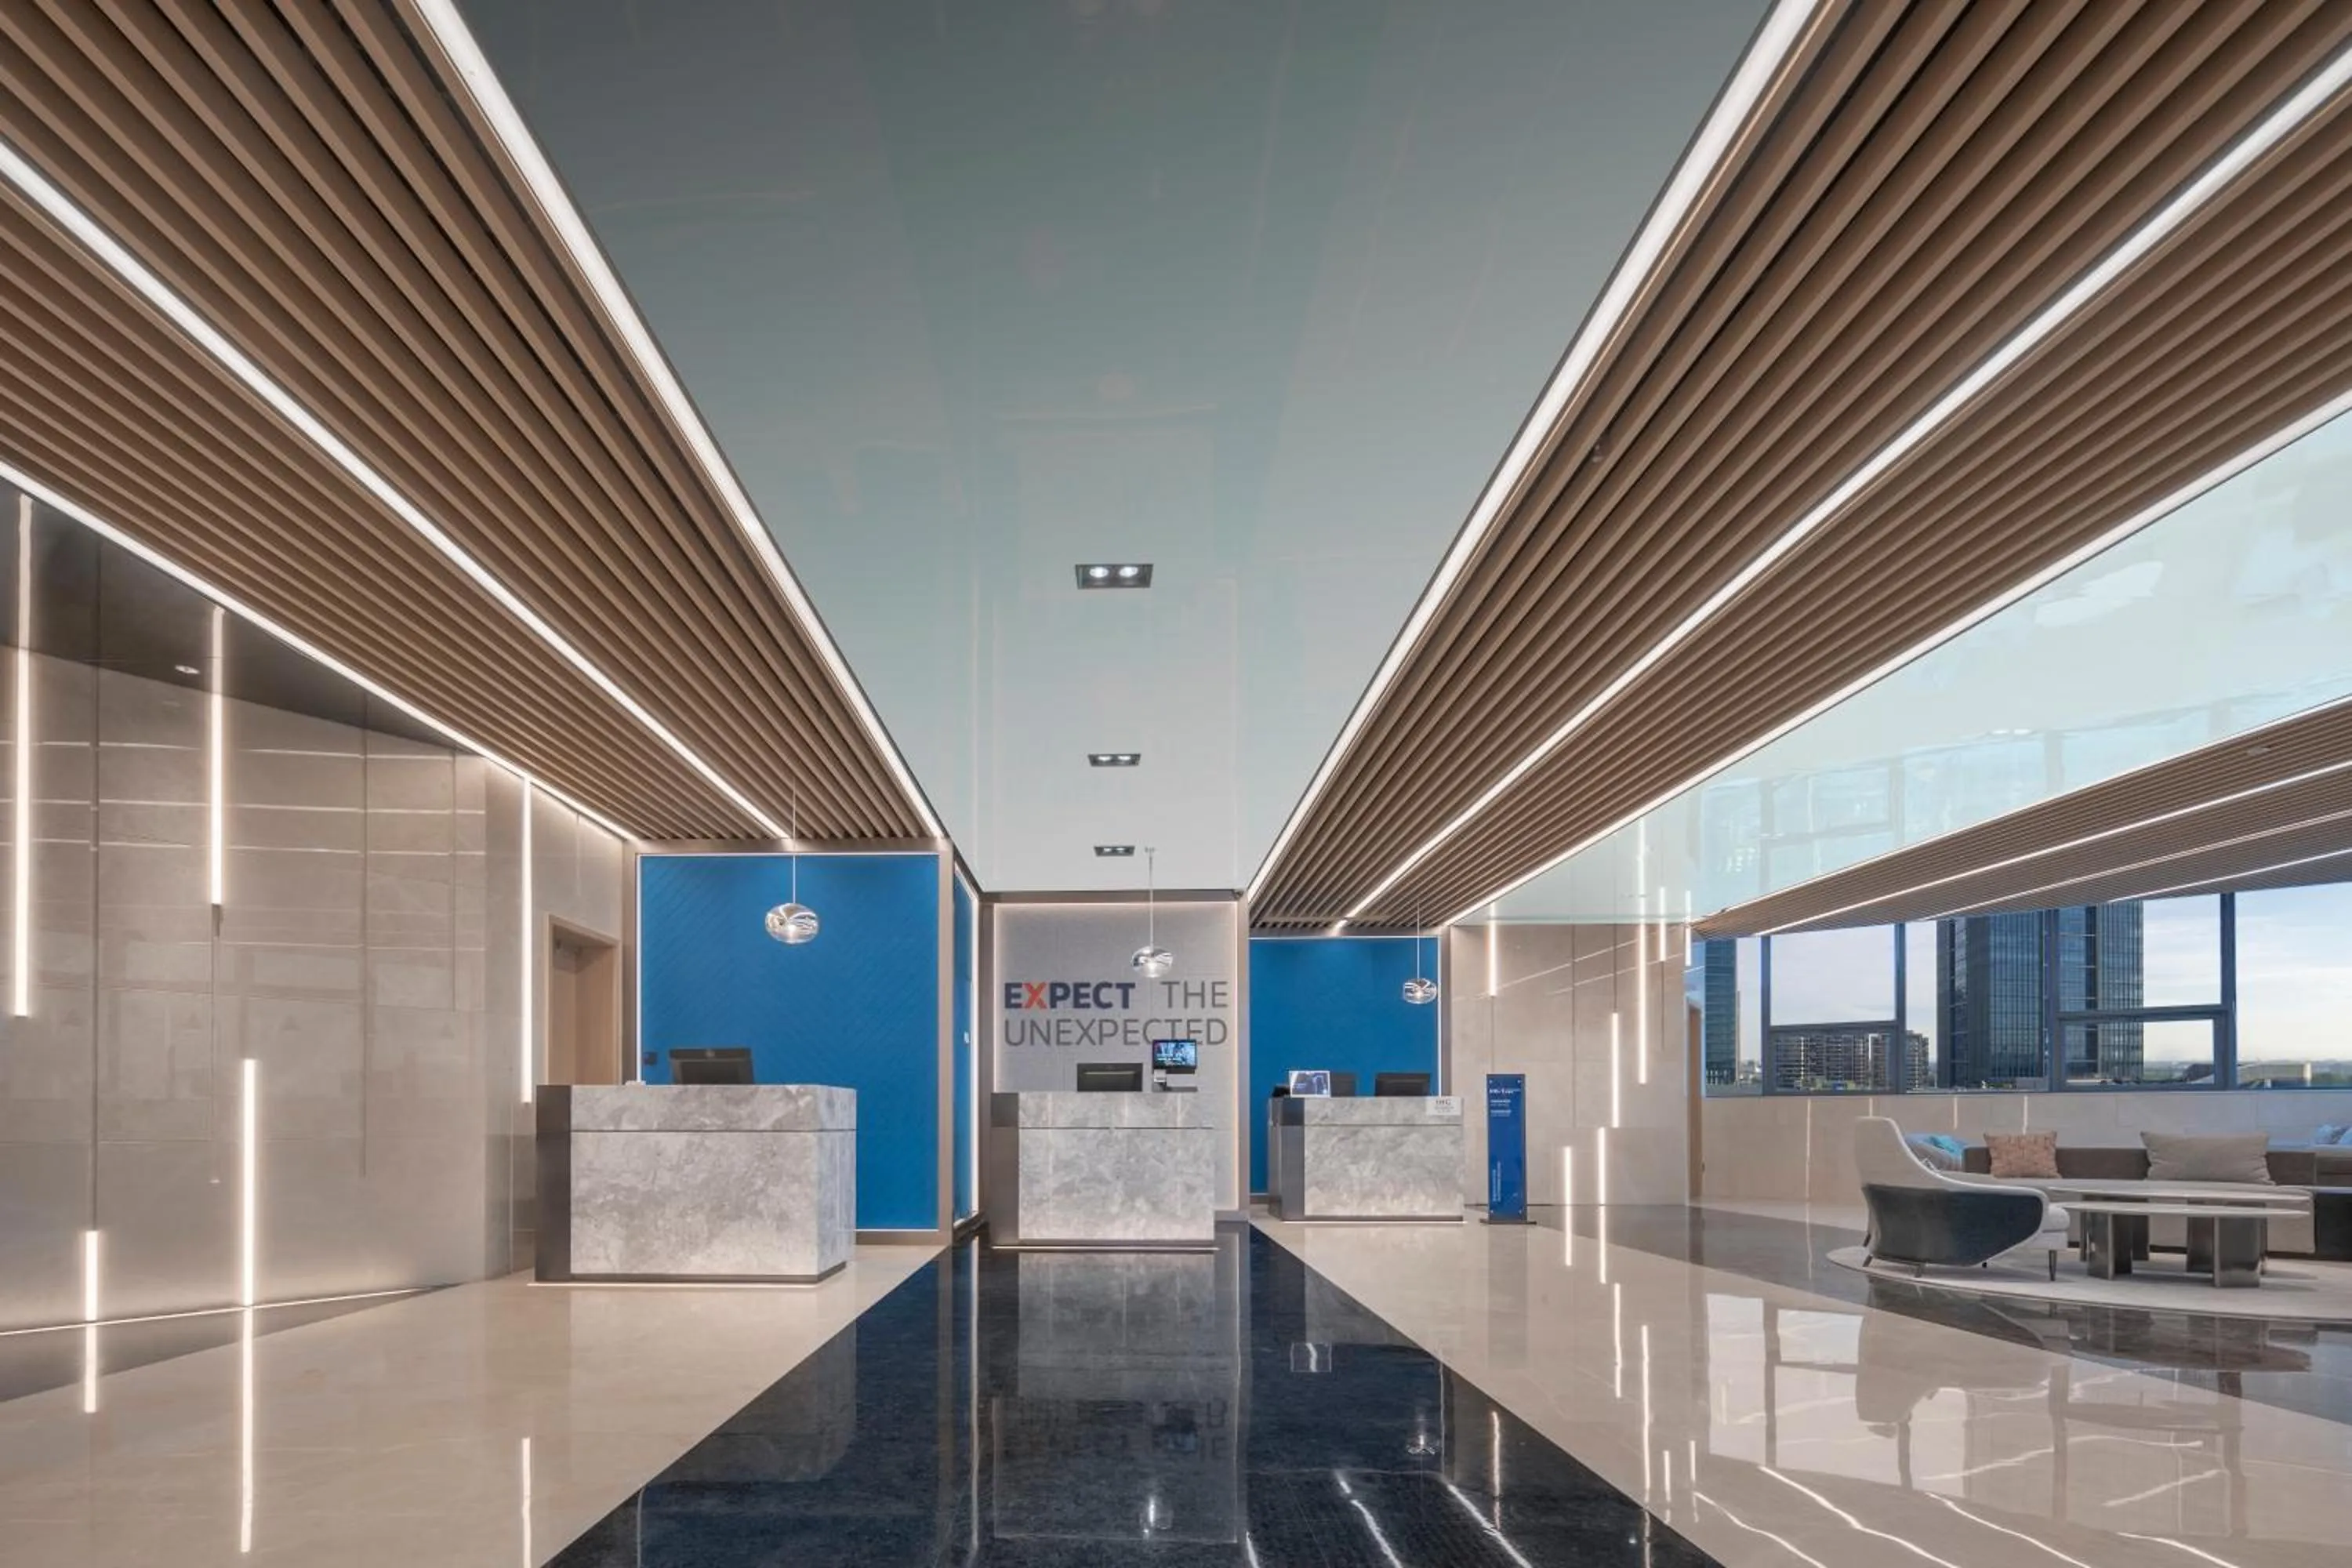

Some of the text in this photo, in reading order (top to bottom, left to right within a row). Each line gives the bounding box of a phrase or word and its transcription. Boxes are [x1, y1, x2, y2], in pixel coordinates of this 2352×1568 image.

[1004, 981, 1229, 1009] EXPECT THE
[1004, 1018, 1228, 1047] UNEXPECTED
